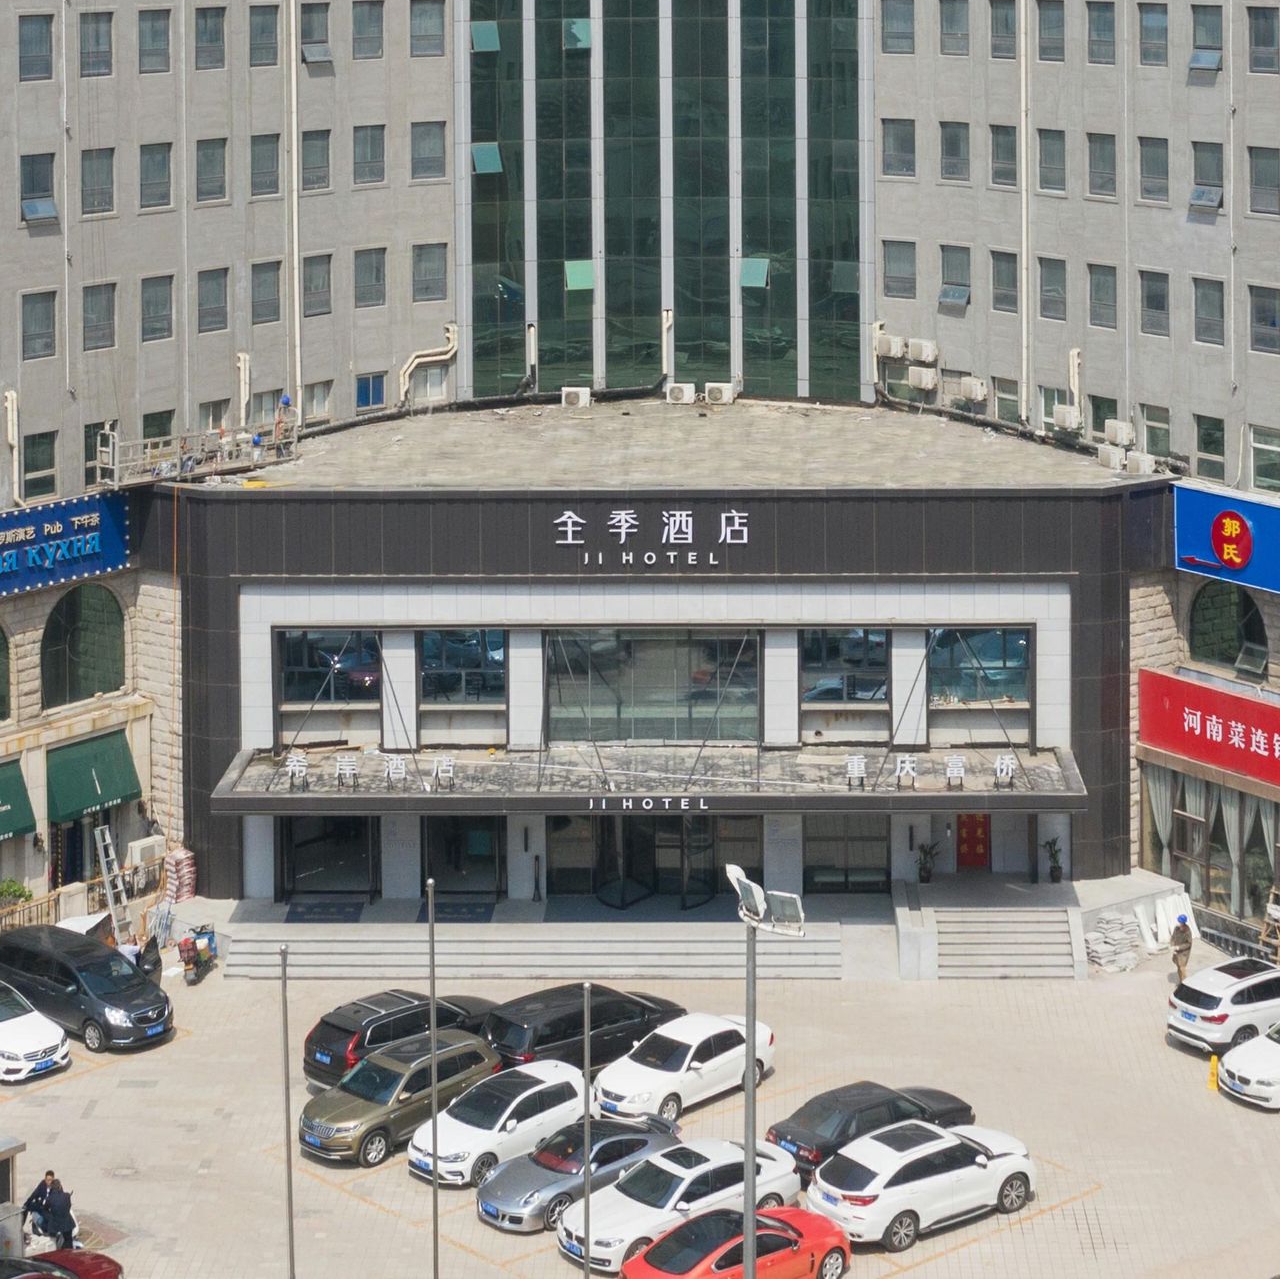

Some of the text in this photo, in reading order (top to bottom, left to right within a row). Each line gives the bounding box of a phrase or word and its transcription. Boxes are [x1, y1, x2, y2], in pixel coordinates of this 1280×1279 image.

[43, 521, 63, 536] Pub
[71, 513, 101, 530] 下午茶
[553, 509, 749, 545] 全季酒店
[1221, 517, 1243, 564] 郭氏
[584, 552, 719, 565] JI HOTEL
[285, 754, 455, 778] 希岸酒店
[845, 754, 1017, 778] 重庆富侨
[589, 798, 709, 810] JI HOTEL
